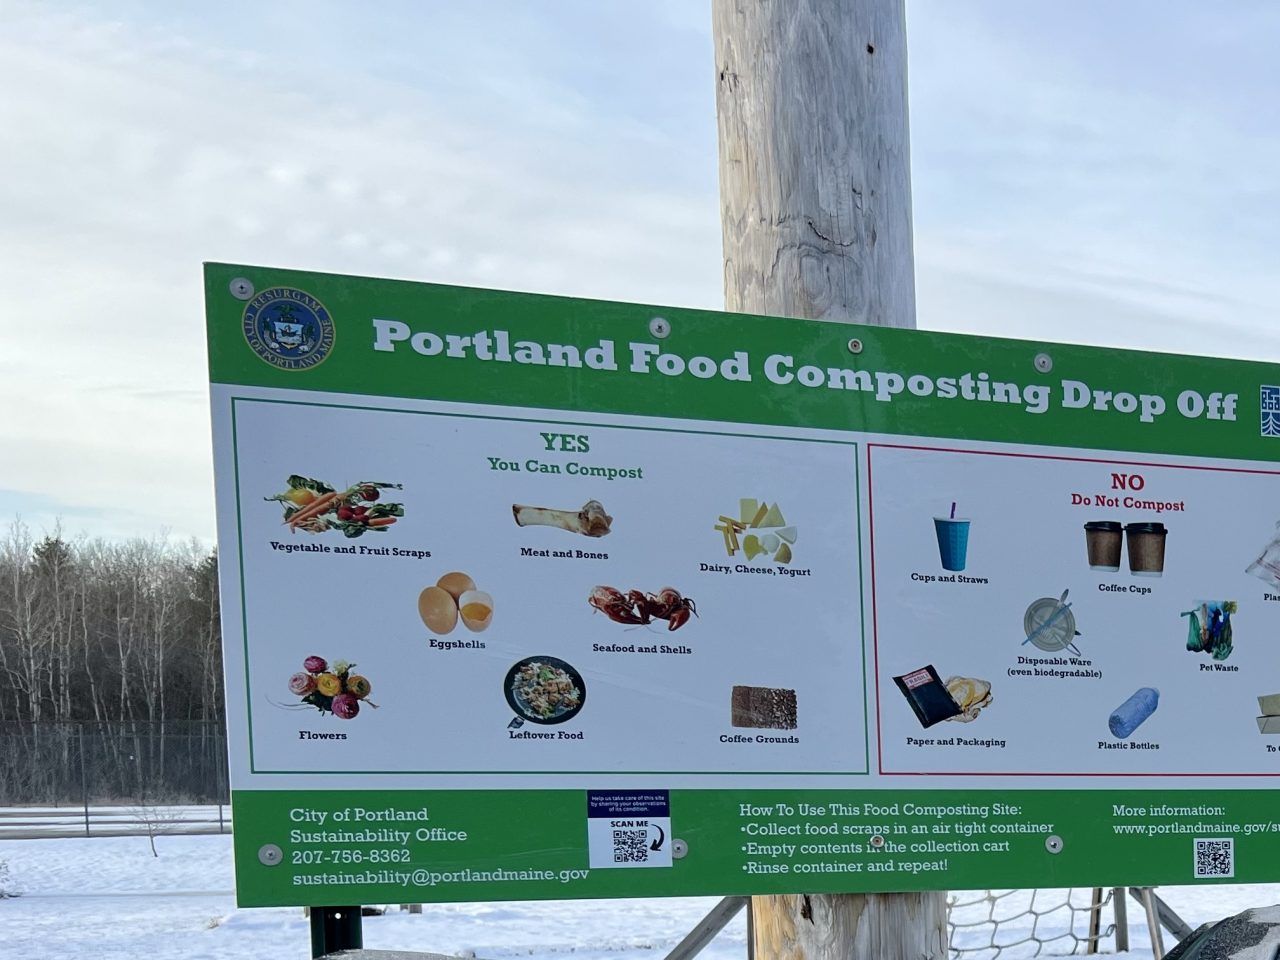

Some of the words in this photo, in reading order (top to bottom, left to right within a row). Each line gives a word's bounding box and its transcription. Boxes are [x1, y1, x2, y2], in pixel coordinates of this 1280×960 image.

[252, 289, 320, 312] RESURGAM
[372, 318, 618, 371] Portland
[629, 341, 752, 382] Food
[763, 353, 1051, 414] Composting
[1061, 379, 1166, 422] Drop
[1176, 389, 1239, 421] Off
[540, 432, 590, 453] YES
[487, 457, 520, 472] You
[525, 460, 561, 474] Can
[566, 462, 643, 480] Compost
[1110, 473, 1145, 491] NO
[1071, 493, 1091, 506] Do
[1094, 494, 1120, 508] Not
[1123, 497, 1185, 512] Compost
[270, 541, 330, 554] Vegetable
[334, 545, 356, 554] and
[360, 546, 390, 556] Fruit
[392, 548, 432, 560] Scraps
[520, 548, 550, 558] Meat
[552, 550, 573, 558] and
[576, 550, 609, 560] Bones
[700, 563, 732, 574] Dairy,
[735, 565, 776, 576] Cheese,
[777, 566, 811, 578] Yogurt
[911, 572, 936, 584] Cups
[938, 574, 956, 583] and
[958, 574, 989, 584] Straws
[1098, 584, 1127, 593] Coffee
[1129, 584, 1152, 595] Cups
[429, 639, 486, 650] Eggshells
[592, 644, 635, 653] Seafood
[638, 644, 658, 654] and
[660, 645, 692, 654] Shells
[1018, 656, 1068, 667] Disposable
[1068, 658, 1092, 666] Ware
[1200, 664, 1214, 672] Pet
[1214, 664, 1239, 672] Waste
[1007, 667, 1032, 677] (even
[1034, 667, 1102, 679] biodegradable)
[299, 730, 348, 740] Flowers
[509, 730, 556, 740] Leftover
[558, 731, 584, 740] Food
[720, 734, 754, 743] Coffee
[756, 735, 800, 744] Grounds
[906, 738, 935, 748] Paper
[937, 738, 954, 746] and
[956, 738, 1006, 748] Packaging
[1098, 741, 1128, 750] Plastic
[1130, 742, 1160, 750] Bottles
[1266, 744, 1276, 752] To
[290, 808, 328, 825] City
[333, 808, 351, 822] of
[354, 807, 429, 822] Portland
[739, 804, 773, 817] How
[776, 804, 794, 817] To
[798, 804, 826, 816] Use
[829, 803, 860, 816] This
[863, 803, 900, 816] Food
[903, 803, 989, 818] Composting
[992, 803, 1022, 816] Site:
[1112, 804, 1146, 816] More
[1150, 804, 1226, 816] information:
[290, 828, 411, 845] Sustainability
[416, 828, 468, 842] Office
[805, 822, 838, 835] food
[842, 825, 890, 837] scraps
[894, 822, 908, 834] in
[911, 825, 929, 834] an
[932, 822, 952, 834] air
[954, 821, 987, 838] tight
[990, 822, 1054, 834] container
[800, 842, 863, 854] contents
[884, 841, 906, 853] the
[910, 840, 980, 853] collection
[982, 841, 1010, 852] cart
[292, 849, 411, 864] 207-756-8362
[793, 860, 863, 873] container
[867, 859, 895, 872] and
[898, 859, 948, 875] repeat!
[293, 866, 590, 886] sustainability@portlandmaine.gov
